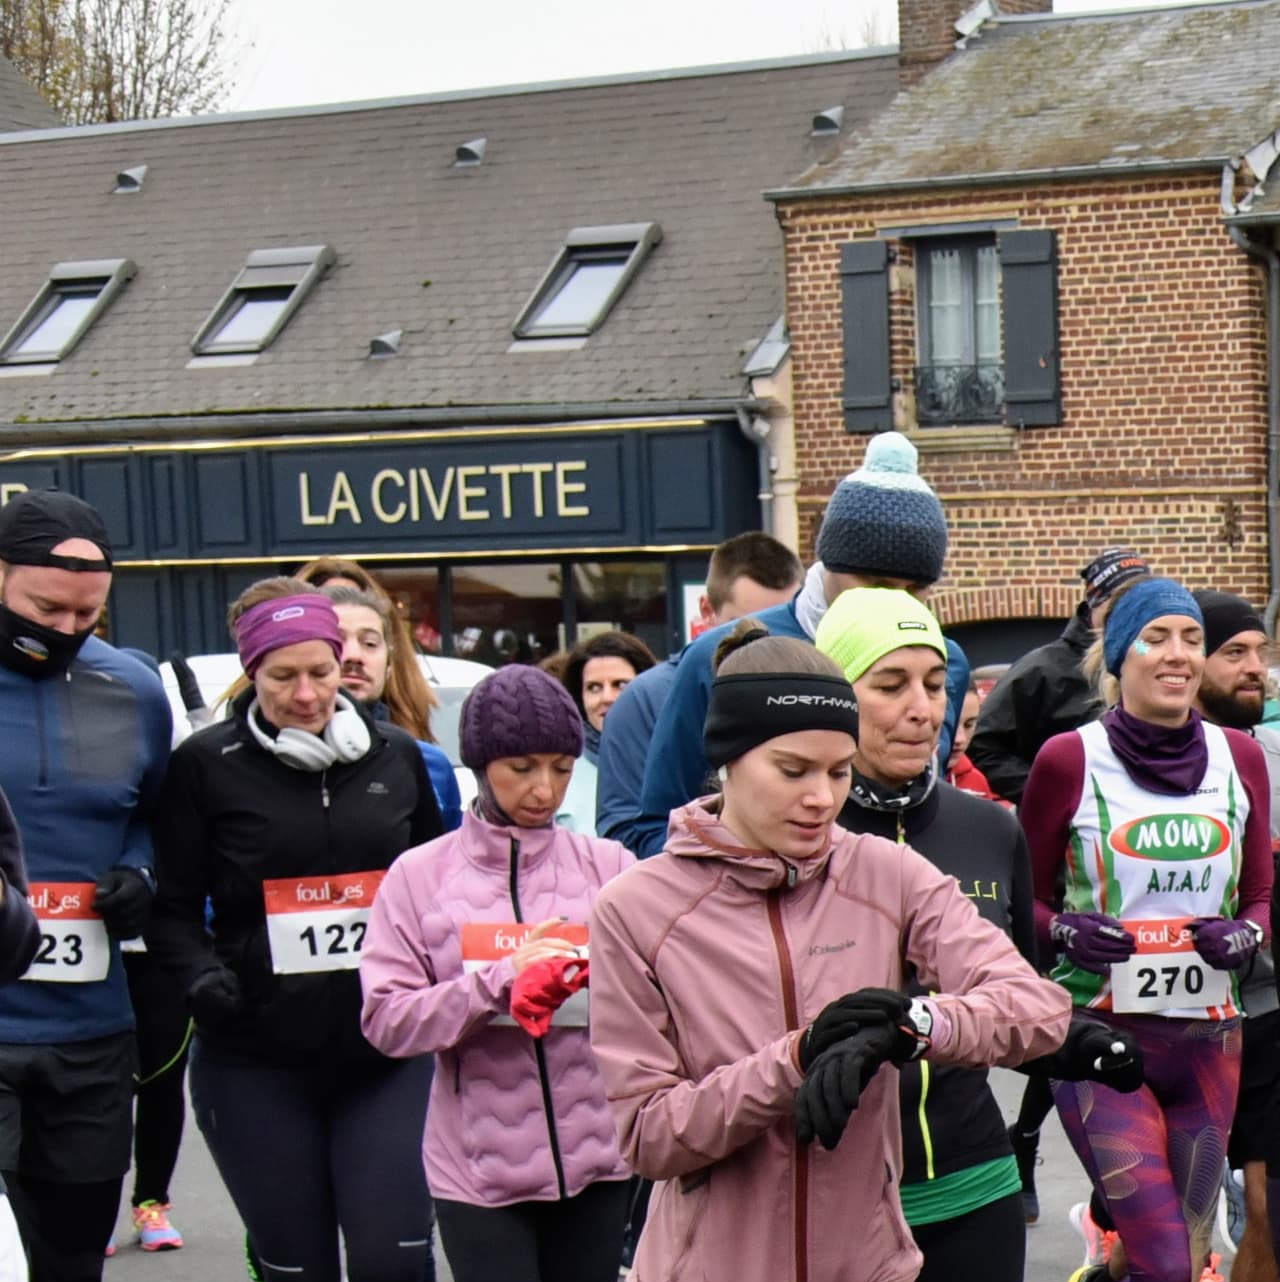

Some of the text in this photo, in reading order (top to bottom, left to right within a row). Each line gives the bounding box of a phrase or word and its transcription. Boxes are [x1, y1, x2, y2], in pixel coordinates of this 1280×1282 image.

[300, 461, 590, 526] LA CIVETTE
[767, 695, 858, 712] NORTHWA
[33, 934, 83, 966] 23
[299, 921, 368, 956] 122
[494, 929, 530, 950] foul
[1137, 965, 1204, 998] 270
